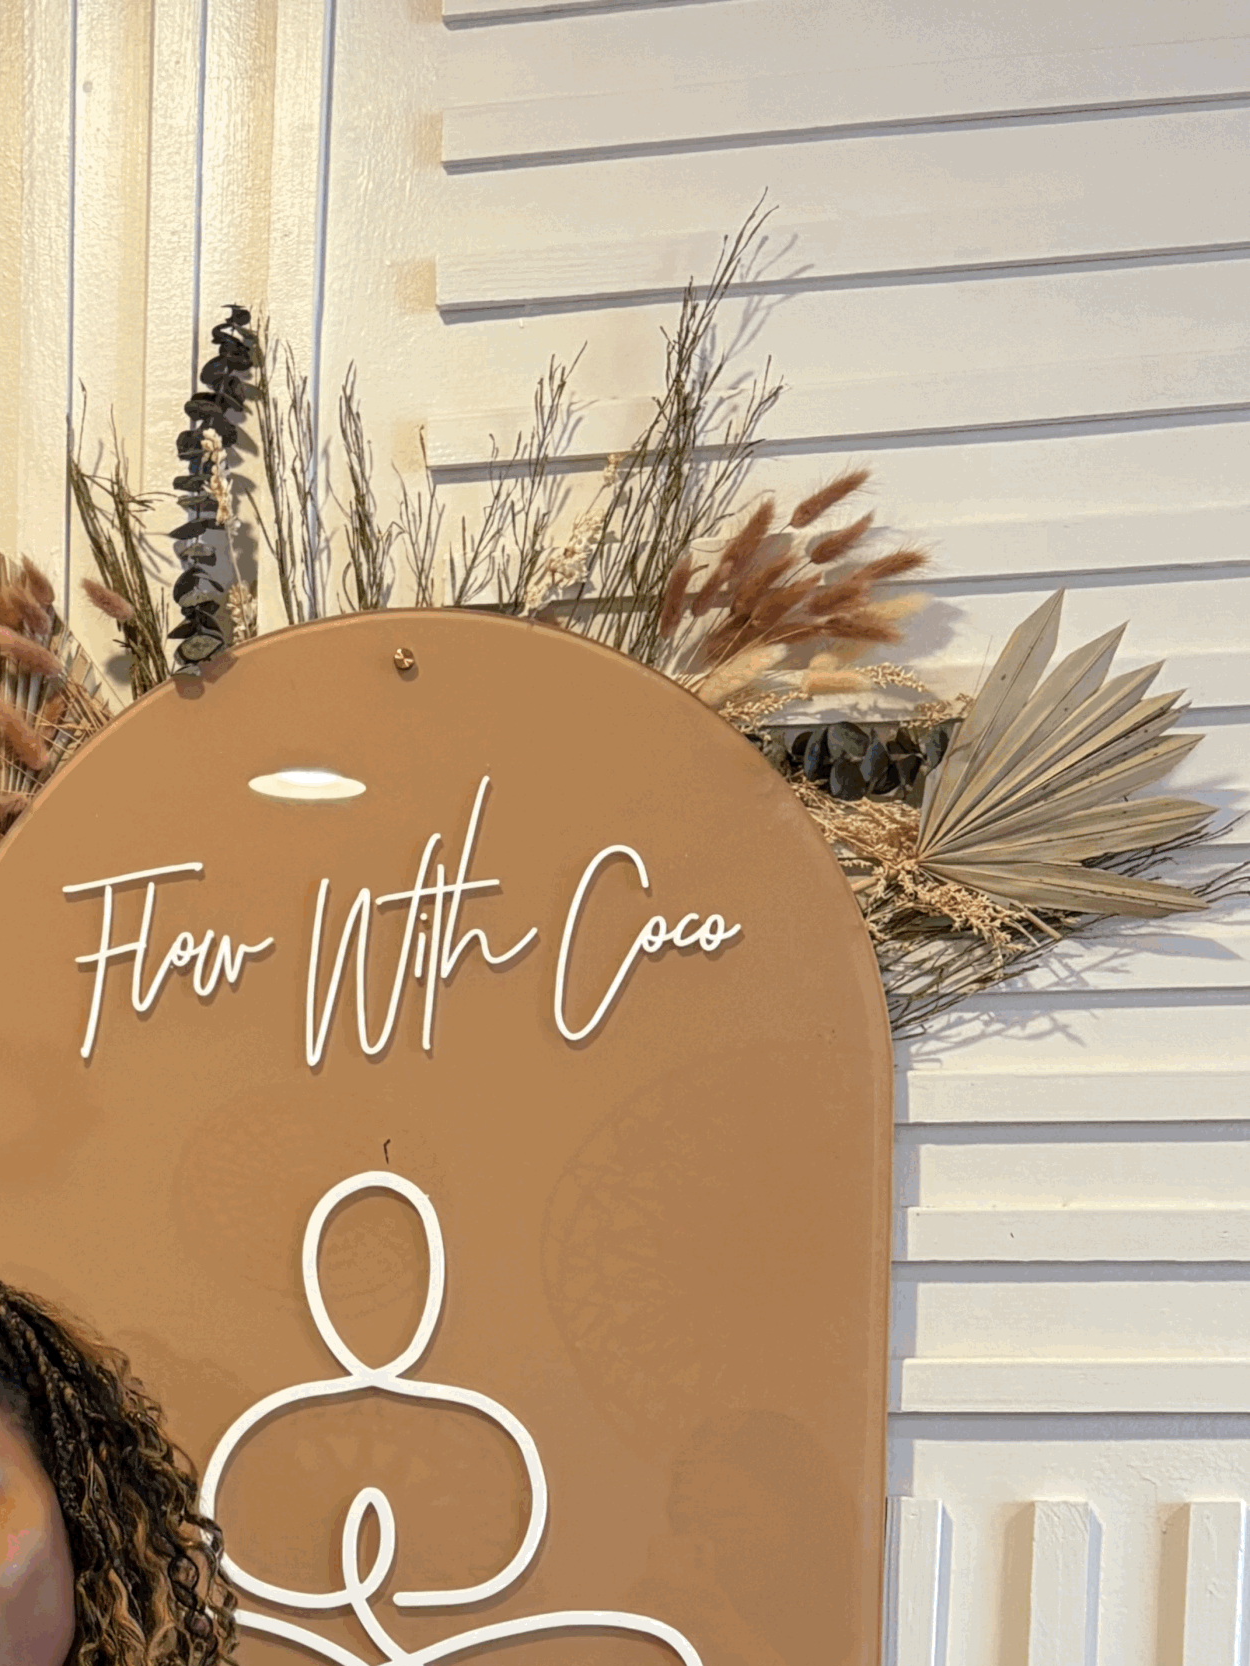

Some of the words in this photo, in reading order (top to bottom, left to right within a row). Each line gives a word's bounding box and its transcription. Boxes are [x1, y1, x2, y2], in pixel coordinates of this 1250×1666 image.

[62, 861, 274, 1059] Flow
[306, 775, 538, 1066] With
[553, 843, 742, 1041] Coco
